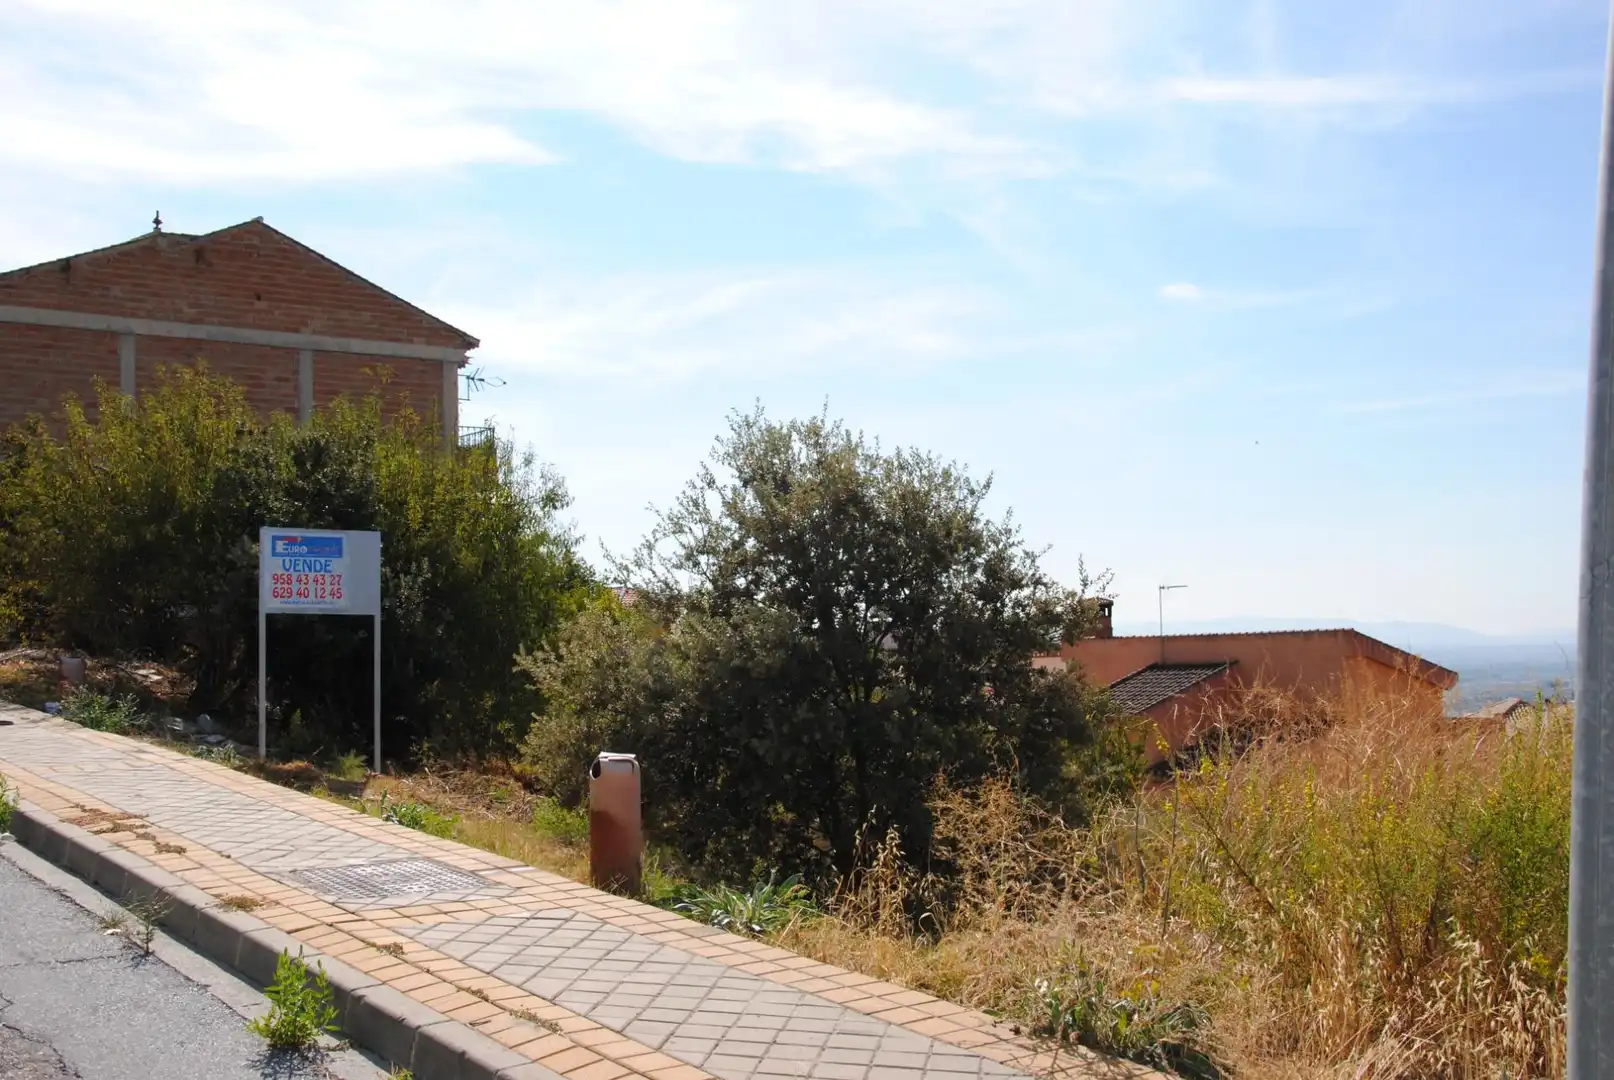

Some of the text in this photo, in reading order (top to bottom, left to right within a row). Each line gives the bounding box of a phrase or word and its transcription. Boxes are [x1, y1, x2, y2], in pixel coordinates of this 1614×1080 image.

[282, 559, 333, 573] VENDE
[272, 573, 342, 586] 958 43 43 27
[272, 587, 343, 599] 629 40 12 45
